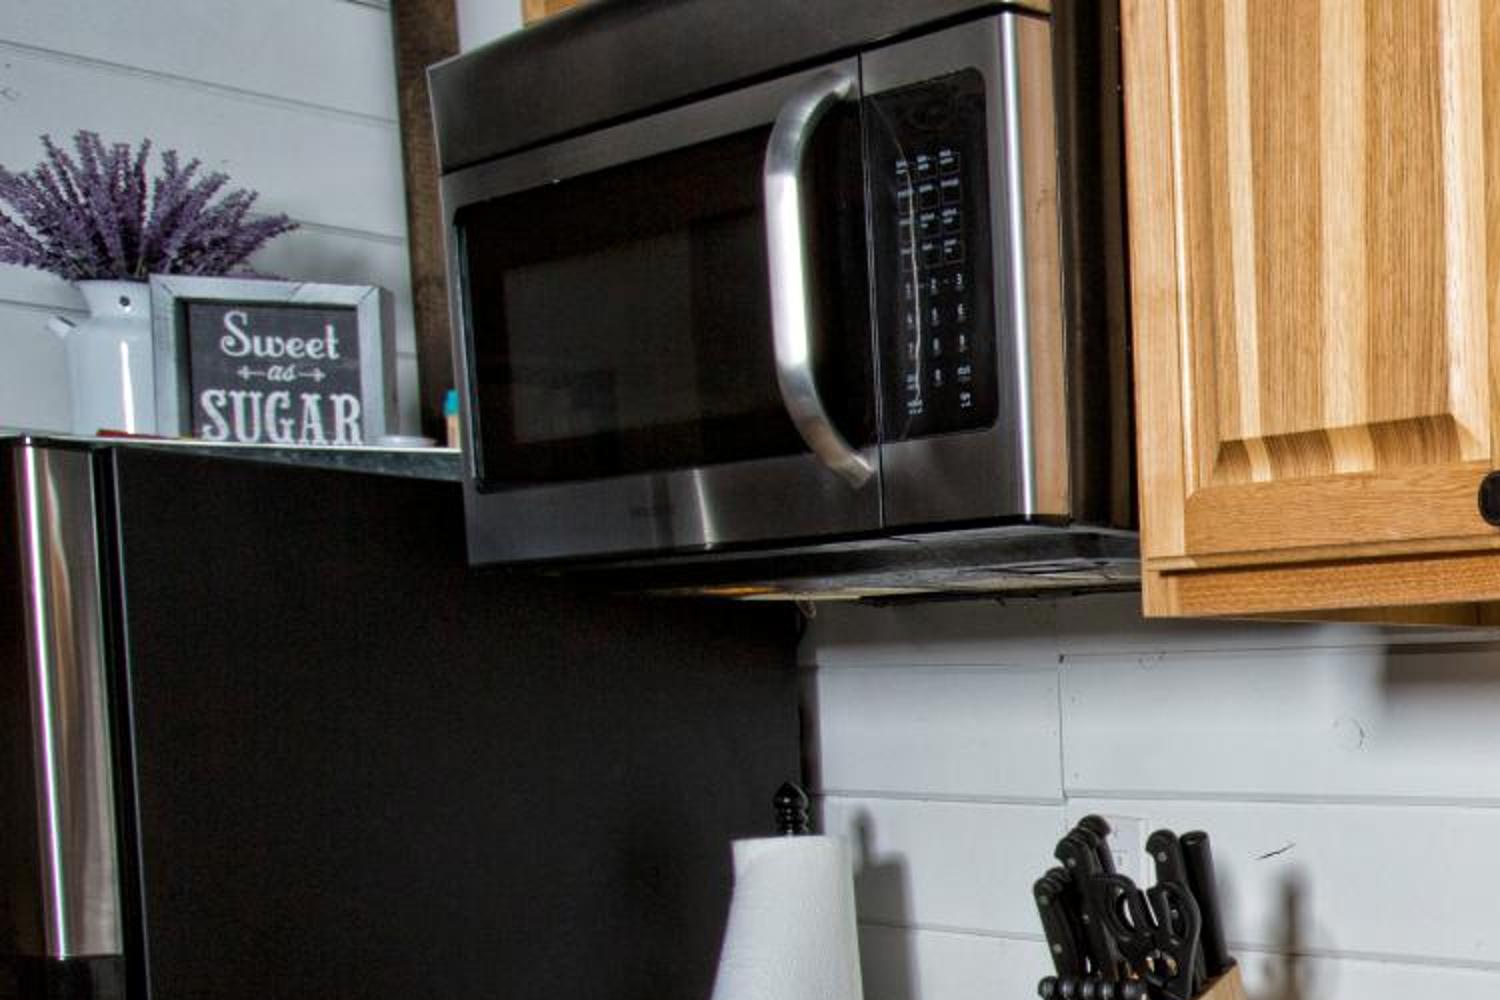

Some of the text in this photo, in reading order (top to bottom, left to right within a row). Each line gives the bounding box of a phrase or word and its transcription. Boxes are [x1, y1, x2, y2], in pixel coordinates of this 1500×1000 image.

[220, 310, 340, 360] Sweet
[267, 364, 298, 383] as
[201, 389, 363, 445] SUGAR
